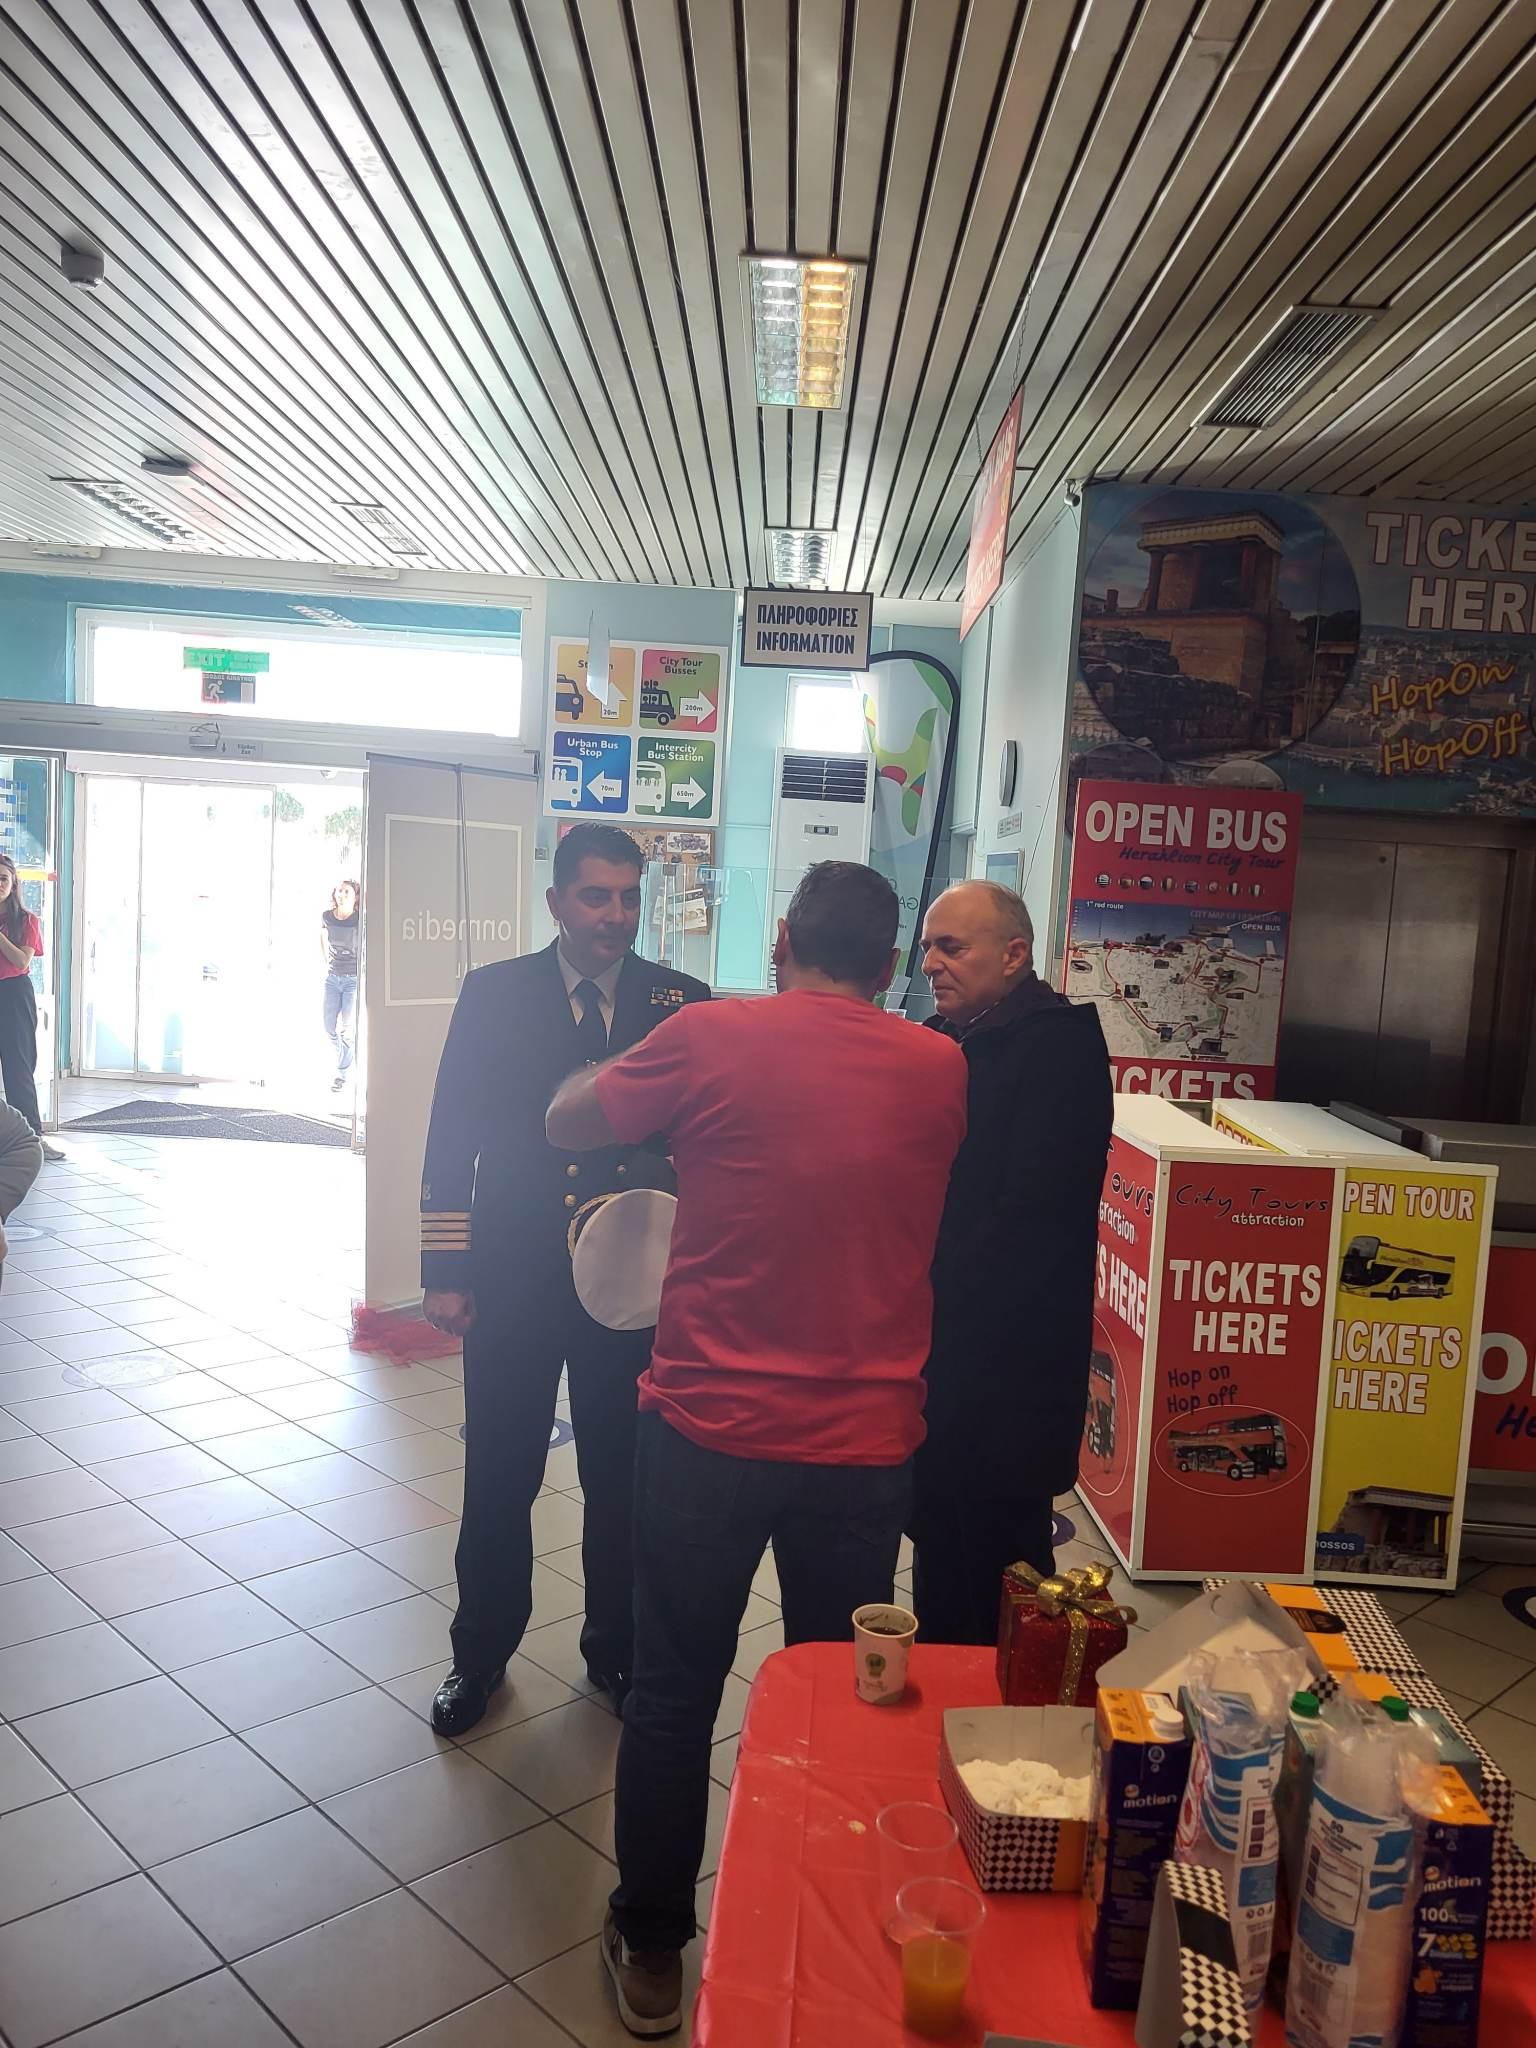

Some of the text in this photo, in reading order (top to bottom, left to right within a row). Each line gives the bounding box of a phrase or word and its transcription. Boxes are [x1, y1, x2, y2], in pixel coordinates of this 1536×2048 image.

[1365, 511, 1536, 573] TICKE
[757, 604, 858, 628] ΠΛΗΡΟΦΟΡΙΕΣ
[1407, 576, 1536, 635] HER
[756, 631, 854, 654] INFORMATION
[659, 656, 703, 668] City Tour
[664, 666, 697, 676] Busses
[685, 704, 703, 712] 200m
[567, 737, 619, 749] Urban Bus
[579, 748, 603, 759] Stop
[655, 742, 697, 753] Intercity
[647, 751, 704, 762] Bus Station
[600, 784, 615, 793] 70m
[676, 790, 694, 798] 650m
[1085, 800, 1287, 853] OPEN BUS
[1111, 1171, 1155, 1218] ours
[1175, 1184, 1329, 1218] City Tours
[1404, 1185, 1475, 1221] TOUR
[1231, 1212, 1305, 1227] attraction
[1169, 1258, 1323, 1308] TICKETS
[1108, 1252, 1148, 1341] HERE
[1192, 1310, 1289, 1356] HERE
[1167, 1364, 1231, 1390] Hop on
[1475, 1331, 1536, 1398] O
[1167, 1384, 1239, 1415] Hop off
[1333, 1367, 1430, 1416] HERE
[1424, 1875, 1482, 1894] motion
